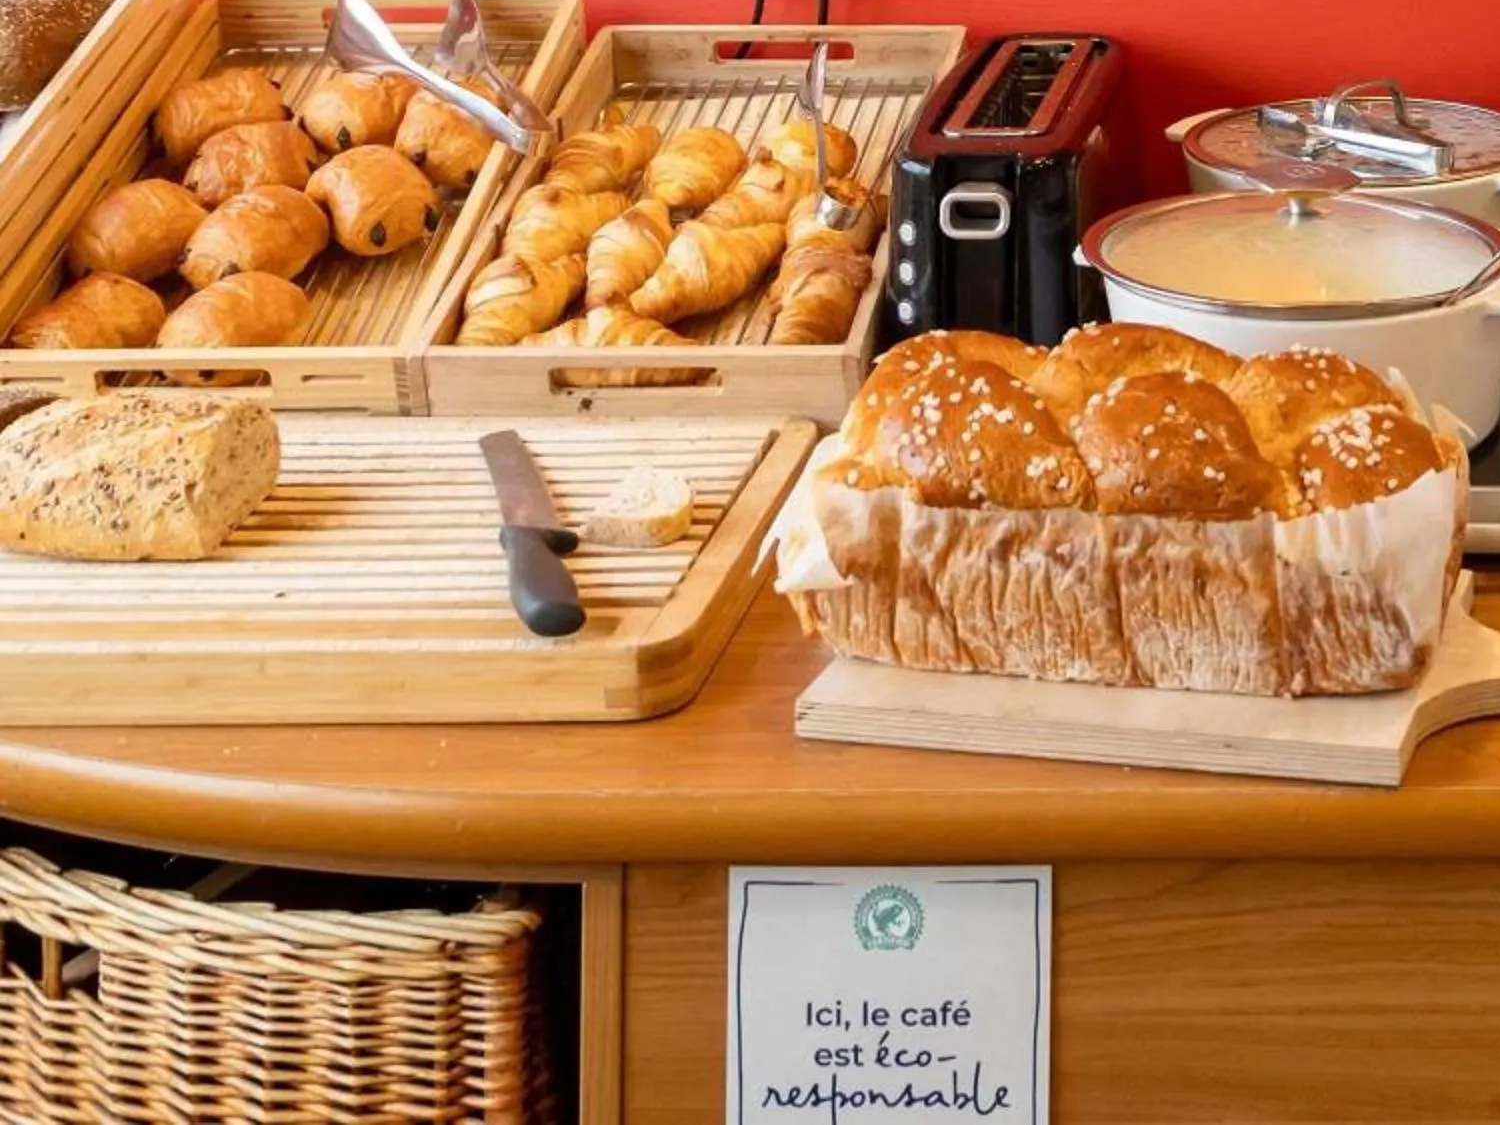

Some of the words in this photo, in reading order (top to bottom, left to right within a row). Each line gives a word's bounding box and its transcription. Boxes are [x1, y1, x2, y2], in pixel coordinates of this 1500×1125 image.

[806, 1001, 852, 1031] Ici,
[863, 1001, 890, 1026] le
[901, 1000, 971, 1026] café
[814, 1044, 864, 1067] est
[876, 1031, 957, 1068] éco-
[761, 1061, 1011, 1125] responsable
